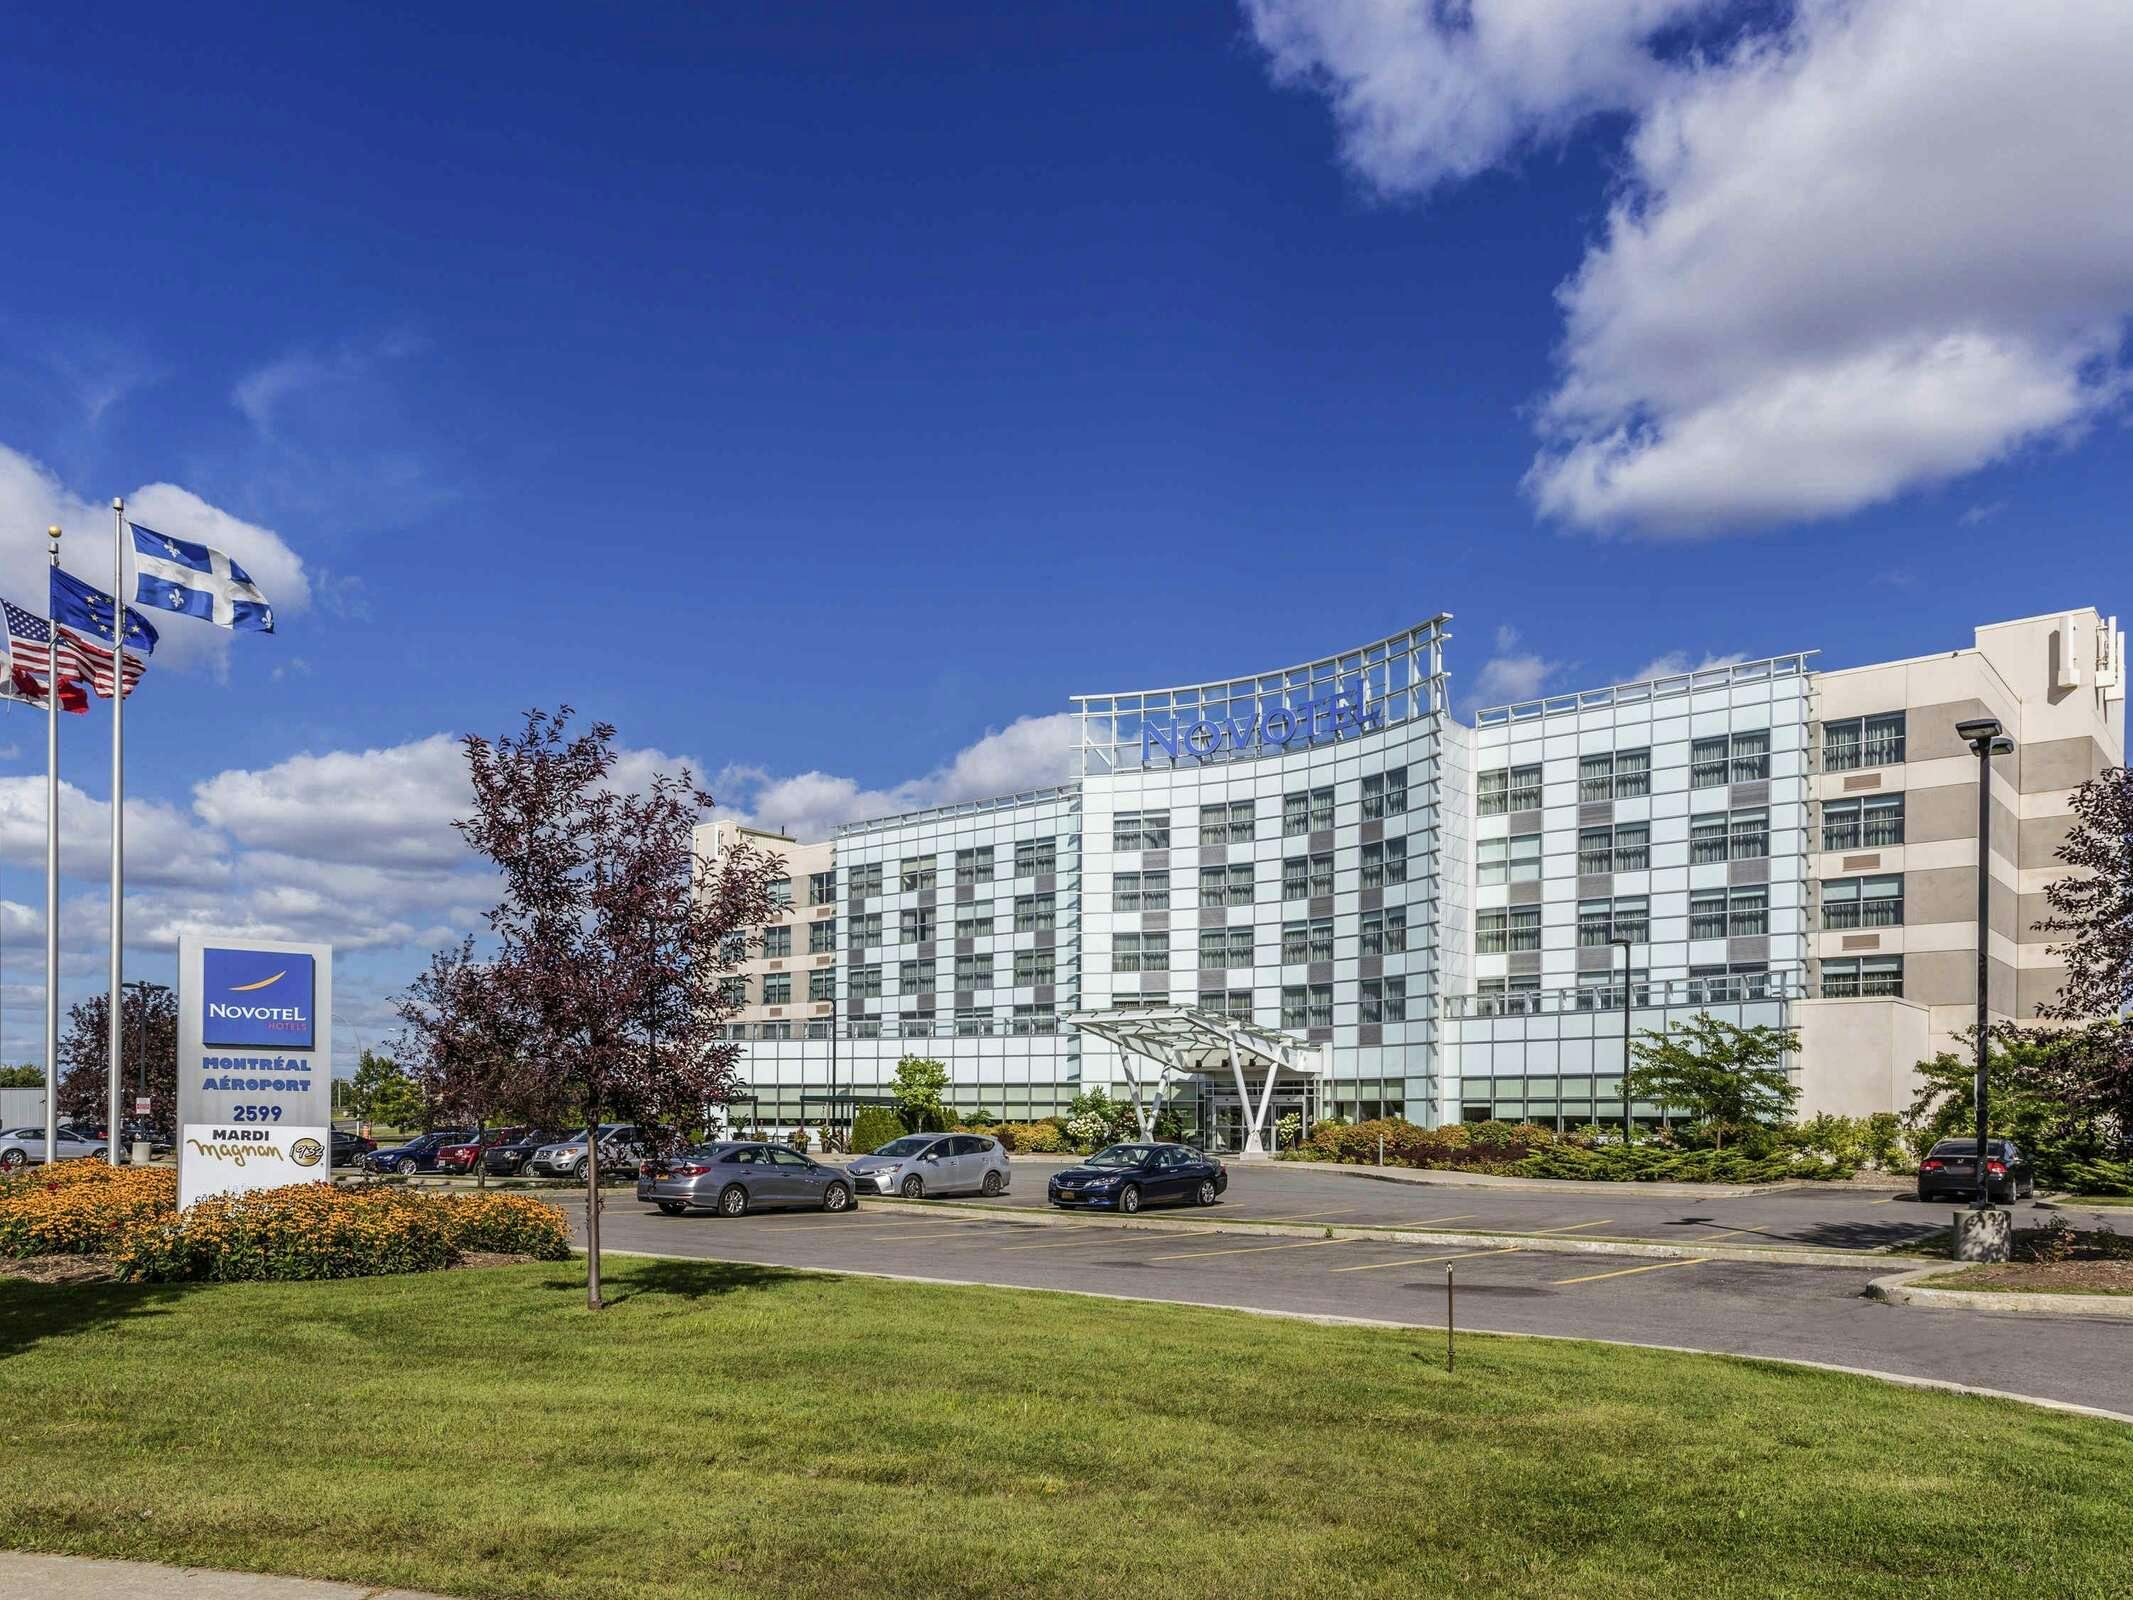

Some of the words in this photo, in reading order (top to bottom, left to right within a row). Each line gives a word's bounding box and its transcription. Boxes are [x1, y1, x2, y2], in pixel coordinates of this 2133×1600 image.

[1142, 678, 1381, 762] NOVOTEL
[208, 1003, 307, 1021] NOVOTEL
[266, 1022, 307, 1032] HOTELS
[202, 1056, 312, 1072] MONTRÉAL
[202, 1075, 311, 1092] AÉROPORT
[233, 1105, 282, 1122] 2599
[212, 1129, 270, 1142] MARDI
[288, 1144, 325, 1161] 1932
